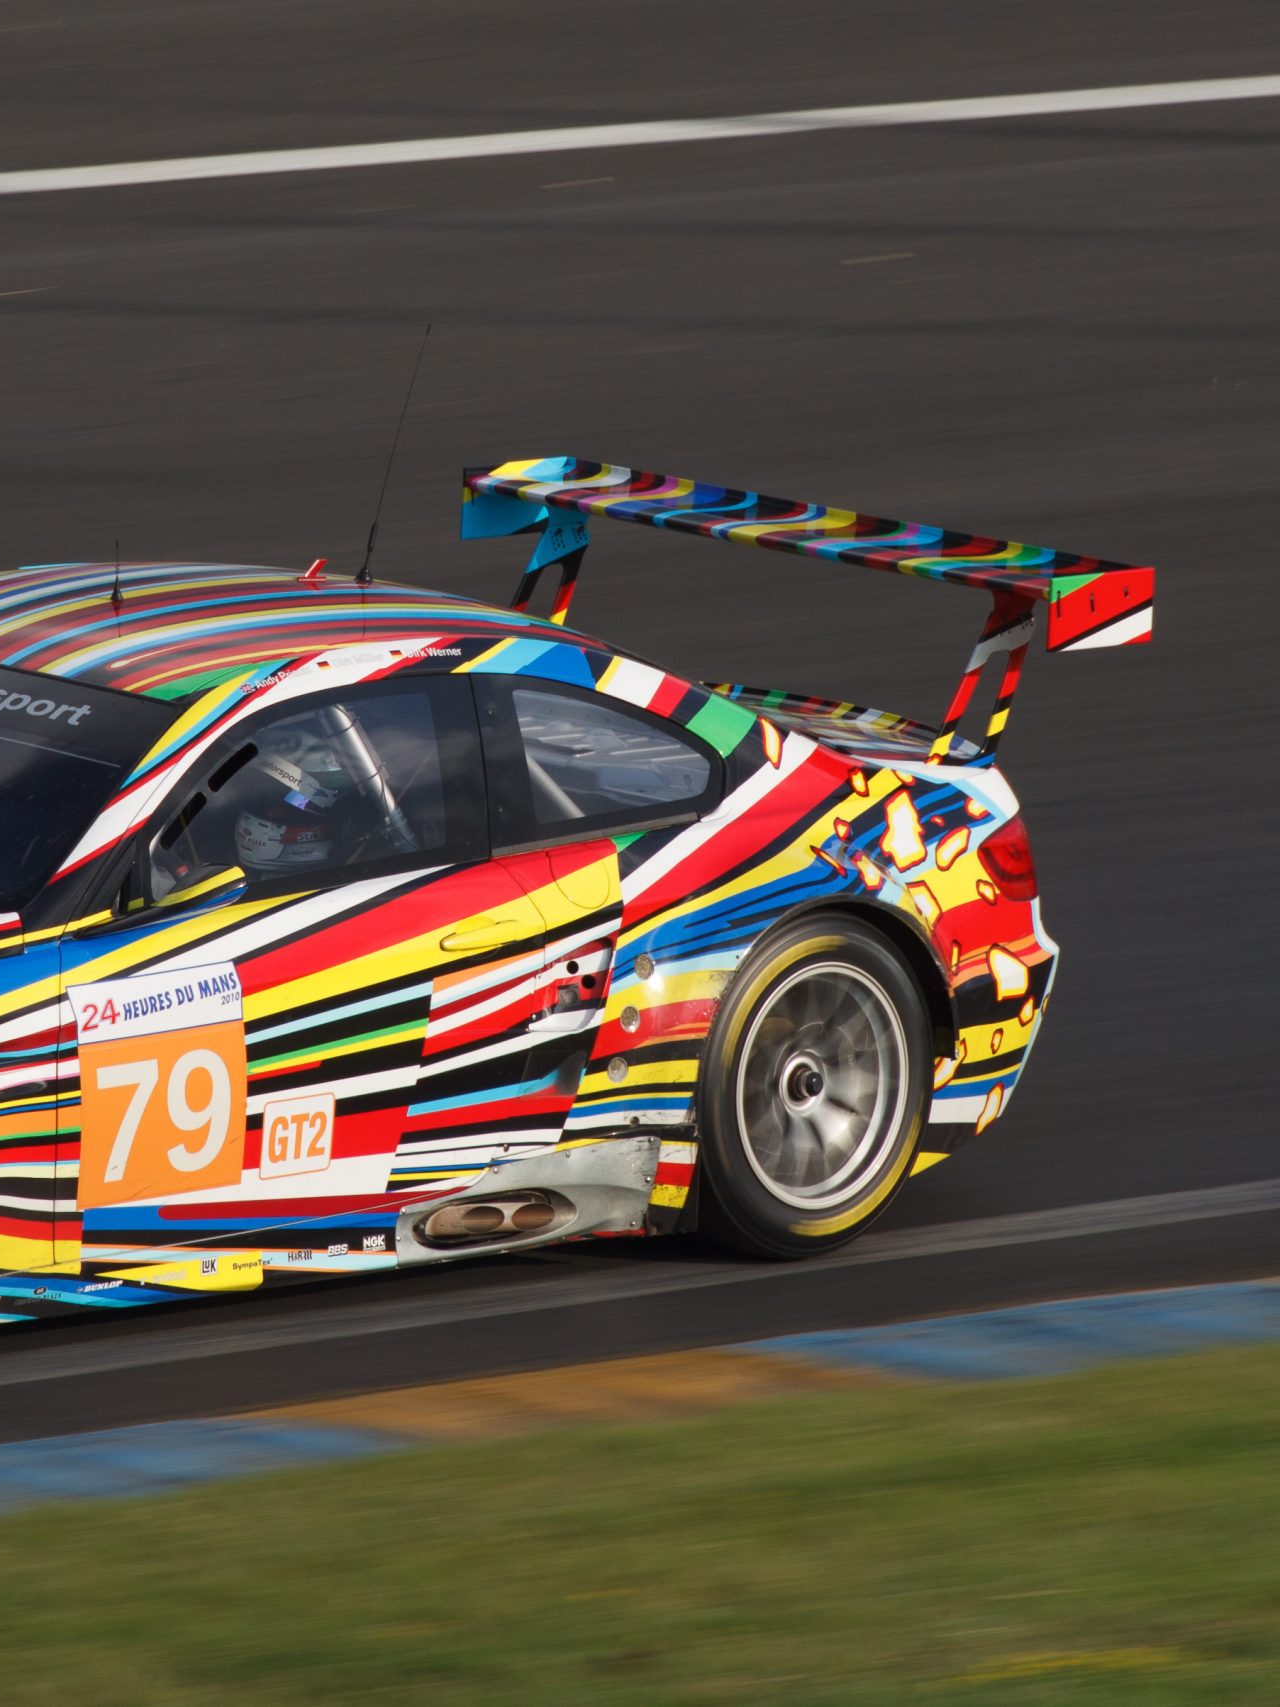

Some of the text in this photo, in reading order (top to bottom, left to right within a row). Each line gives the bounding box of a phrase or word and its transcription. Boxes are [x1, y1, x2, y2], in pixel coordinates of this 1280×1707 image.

[425, 647, 462, 657] Werner
[255, 673, 280, 690] Andy
[81, 972, 238, 1032] 24 HEURES DU MANS
[221, 991, 240, 1006] 2010
[96, 1048, 232, 1184] 79
[268, 1111, 328, 1163] GT2
[363, 1234, 386, 1249] NGK
[328, 1243, 349, 1256] BBS
[232, 1258, 272, 1271] SympaTex
[83, 1280, 124, 1294] DUNLOP
